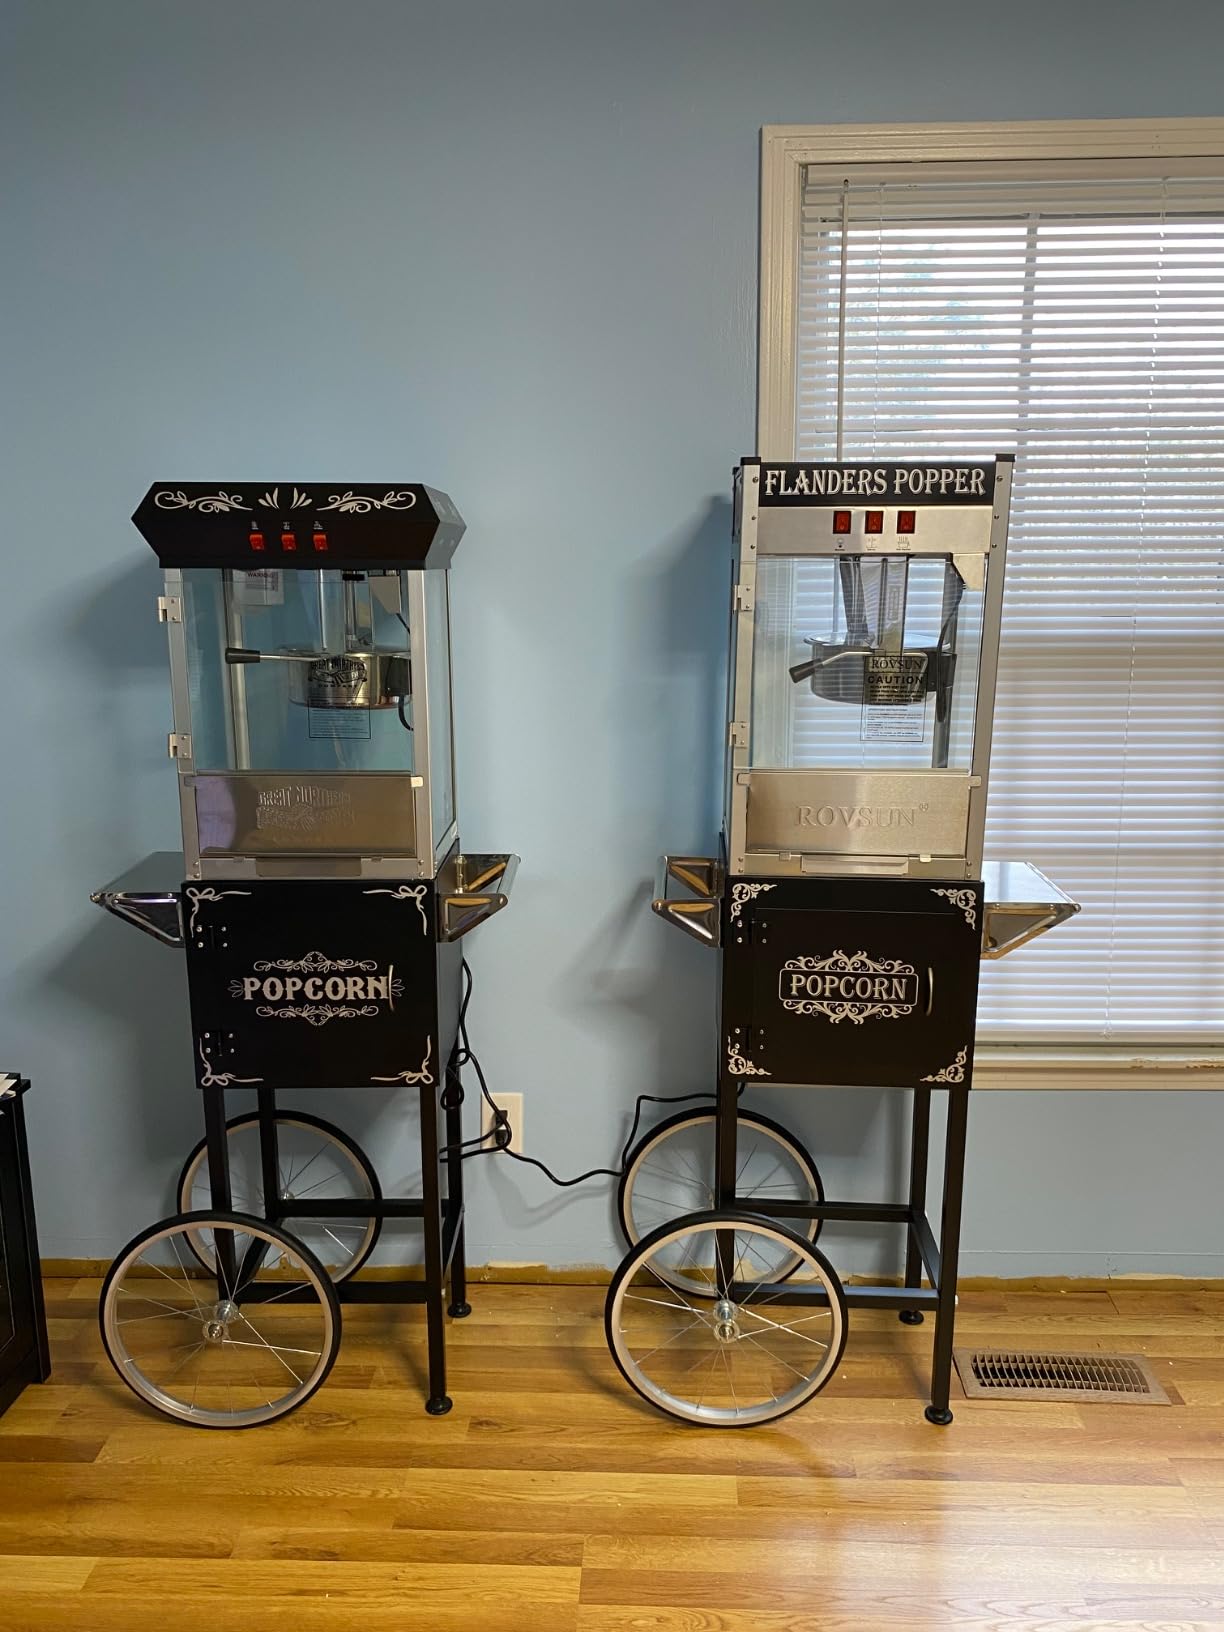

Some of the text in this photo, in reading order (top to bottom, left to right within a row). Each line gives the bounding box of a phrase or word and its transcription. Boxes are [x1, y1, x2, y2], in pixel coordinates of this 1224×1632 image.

[765, 468, 986, 496] FLANDERS POPPER
[867, 675, 923, 685] CAUTION
[243, 975, 390, 1001] POPCORN
[789, 973, 908, 1001] POPCORN
